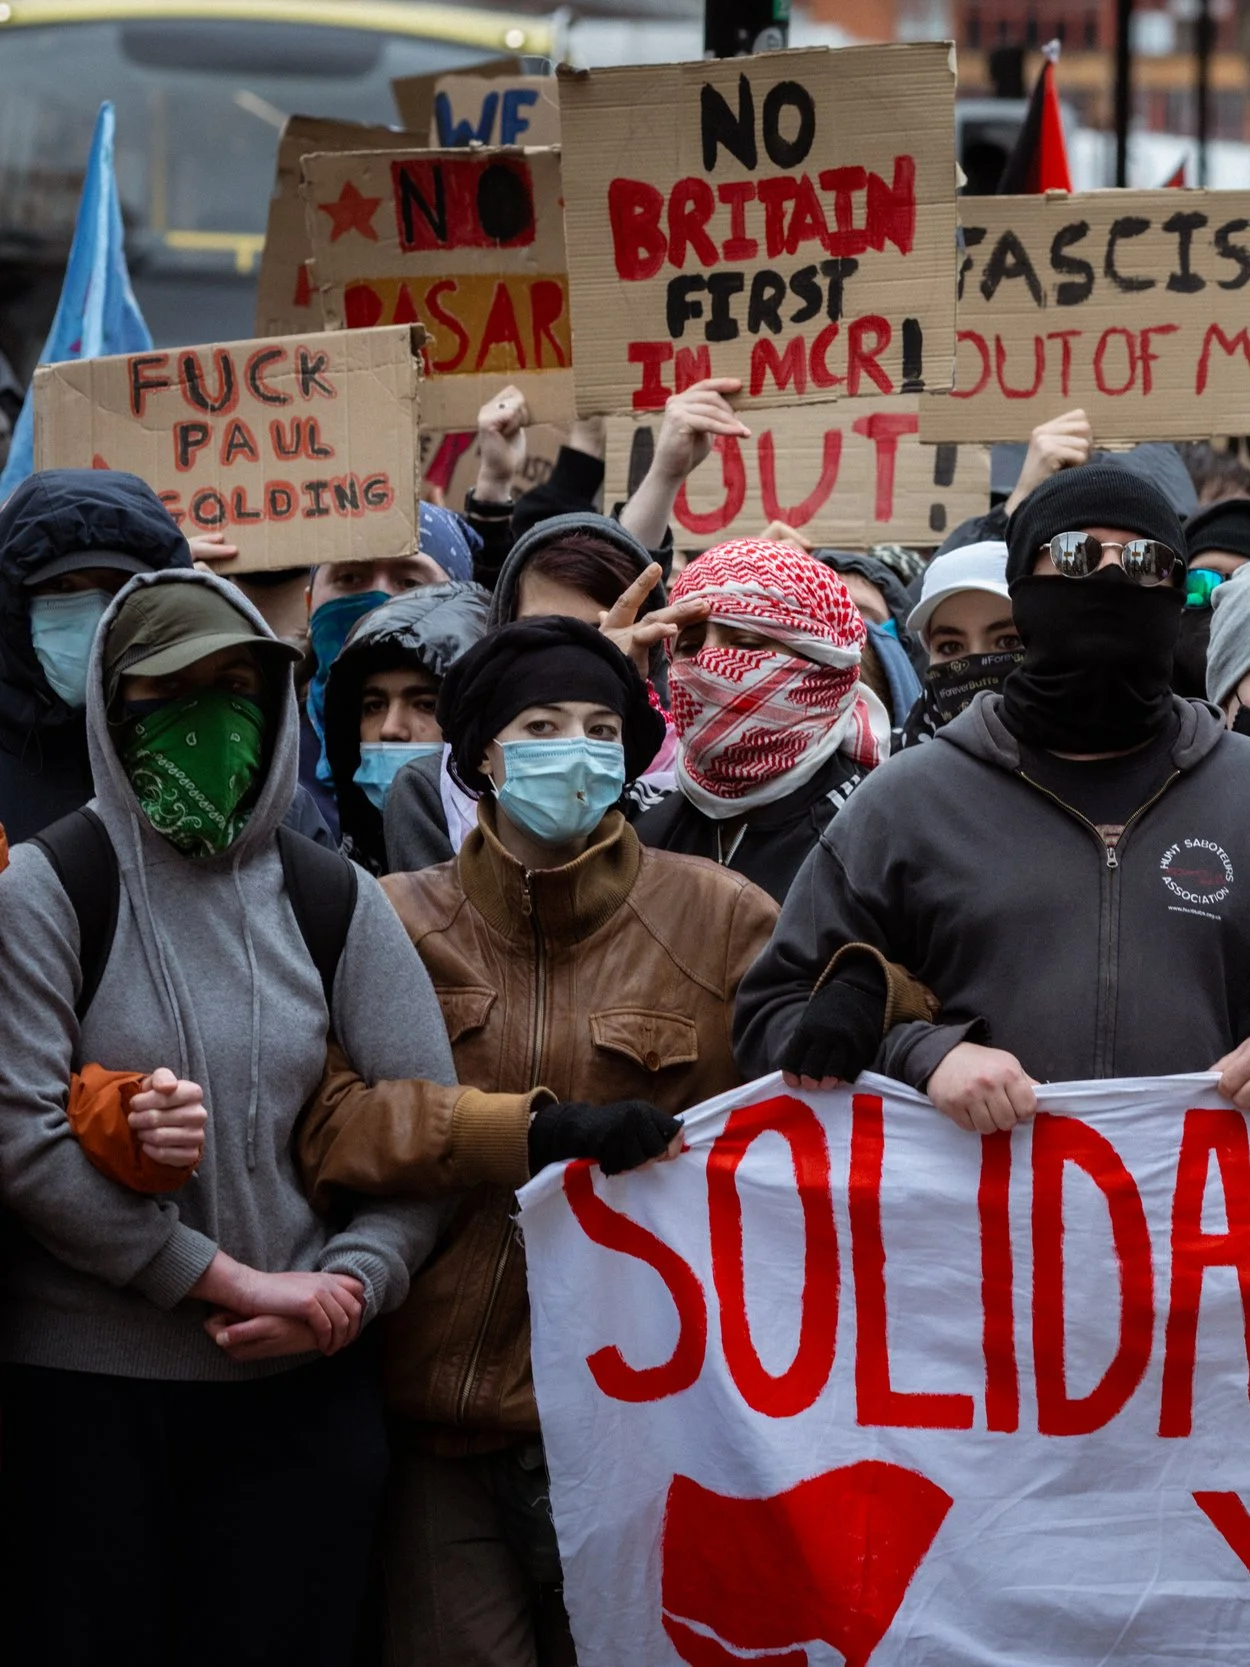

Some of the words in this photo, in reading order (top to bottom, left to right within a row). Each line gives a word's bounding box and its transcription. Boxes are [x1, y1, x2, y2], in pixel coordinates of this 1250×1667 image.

[700, 72, 816, 172] NO
[399, 163, 534, 244] NO
[608, 154, 917, 282] BRITAIN
[666, 257, 859, 342] FIRST
[127, 345, 337, 418] FUCK
[627, 341, 712, 411] IN
[749, 314, 926, 397] MCR!
[950, 329, 1083, 400] OUT
[1094, 323, 1181, 397] OF
[173, 415, 335, 473] PAUL
[1160, 843, 1181, 870] HUNT
[1184, 838, 1234, 883] SABOTEURS
[1161, 875, 1230, 905] ASSOCIATION
